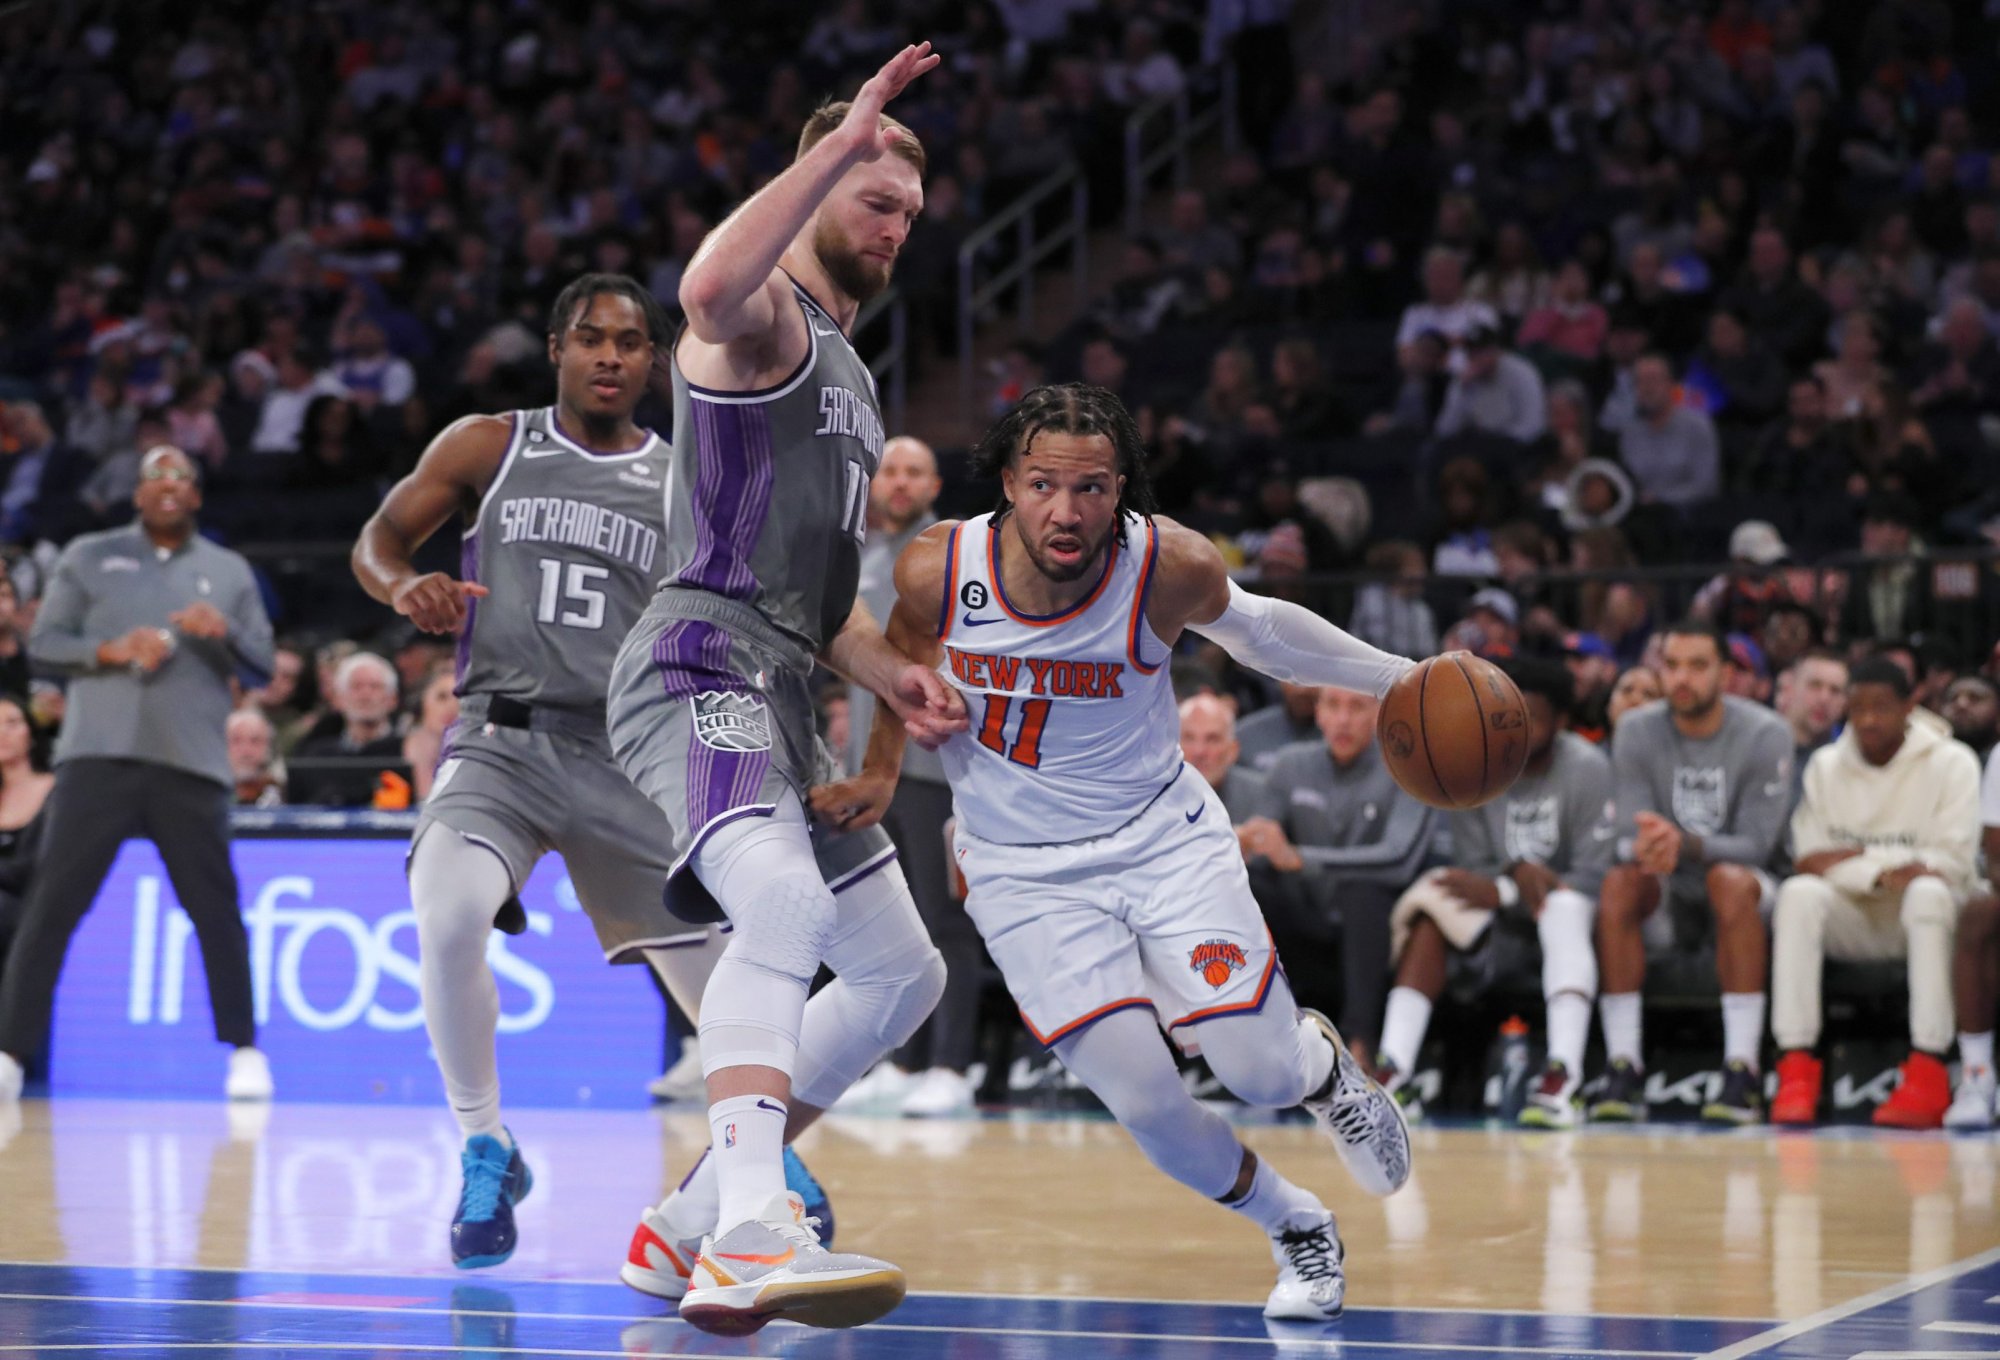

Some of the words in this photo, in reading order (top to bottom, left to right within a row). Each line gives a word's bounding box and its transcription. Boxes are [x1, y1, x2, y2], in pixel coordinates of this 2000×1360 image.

[501, 498, 658, 573] SACRAMENTO
[538, 558, 610, 630] 15
[967, 584, 982, 606] 6
[947, 646, 1021, 692] NEW
[1024, 657, 1125, 698] YORK
[977, 693, 1052, 770] 11
[128, 874, 556, 1042] Ifoss
[1189, 943, 1246, 969] KNICKS
